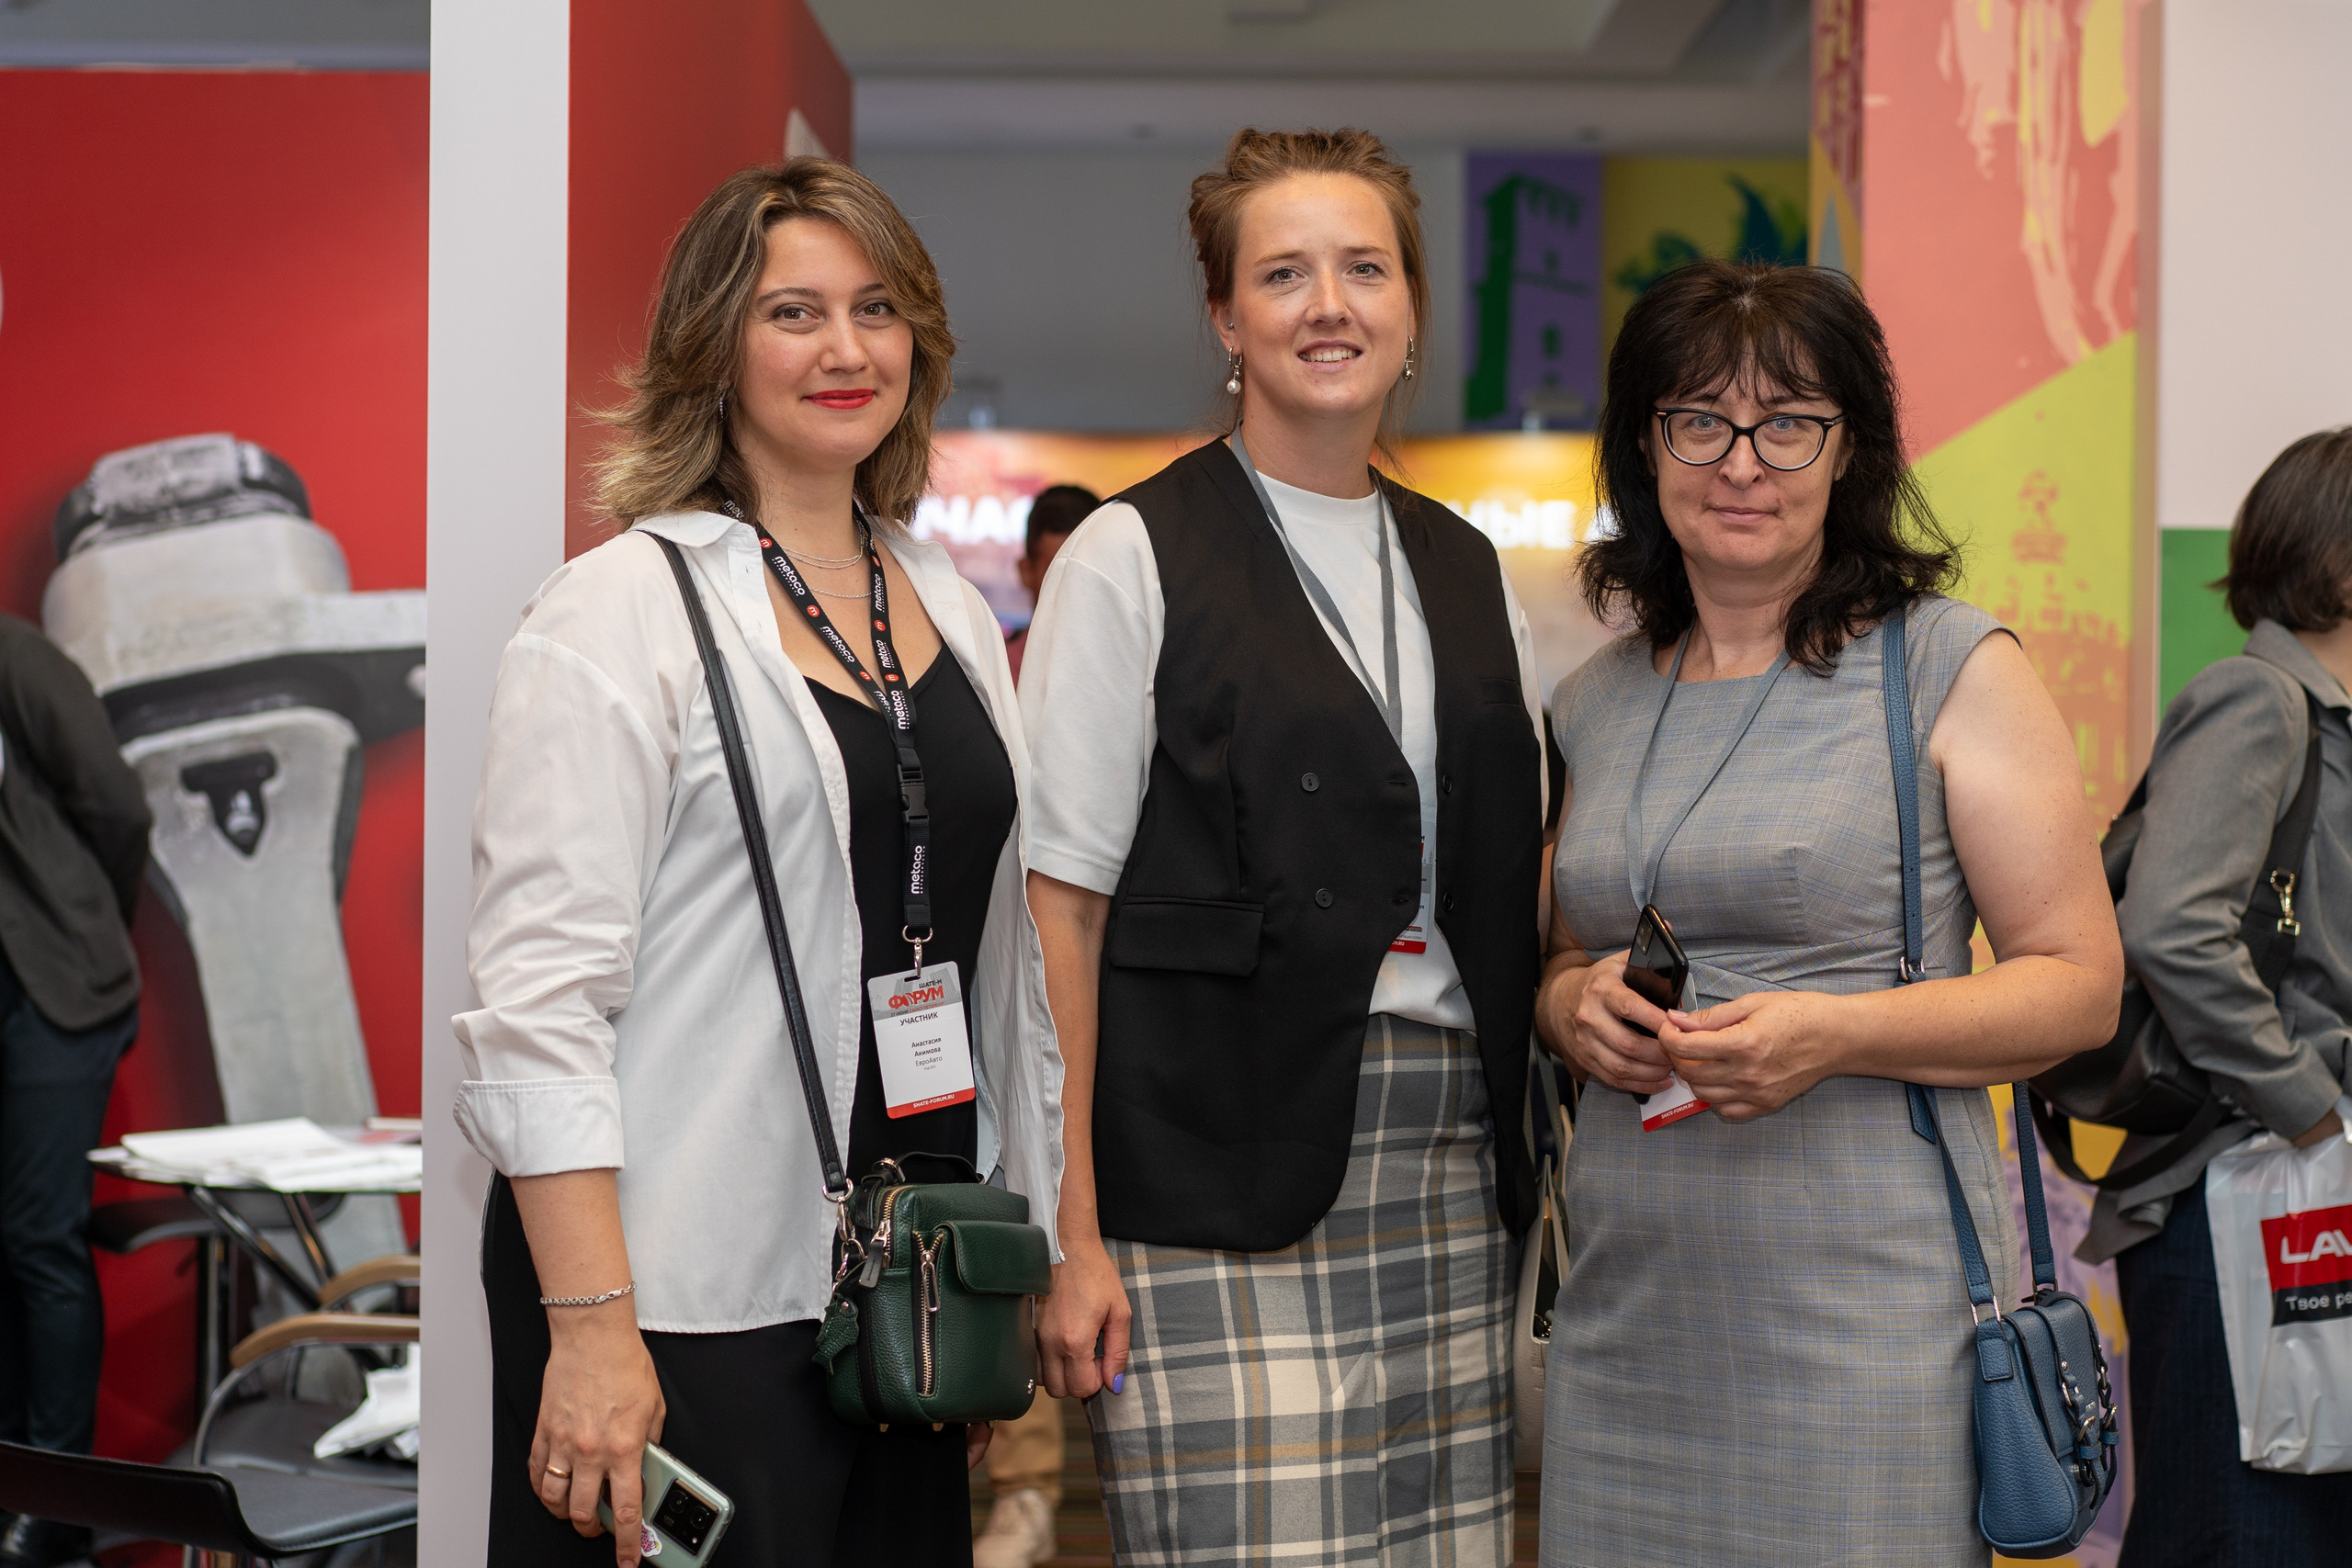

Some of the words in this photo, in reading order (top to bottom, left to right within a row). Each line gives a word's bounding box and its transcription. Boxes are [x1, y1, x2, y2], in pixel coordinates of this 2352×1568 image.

[775, 556, 806, 595] metaco
[875, 573, 883, 612] metaco
[822, 626, 855, 663] metaco
[876, 639, 892, 669] metaco
[890, 690, 907, 730] metaco
[910, 845, 922, 895] metaco
[919, 978, 943, 989] ШАТЕ-М
[899, 1011, 939, 1026] УЧАСТНИК
[911, 1037, 942, 1048] Анастасия
[914, 1046, 942, 1057] Акимова
[915, 1055, 943, 1066] ЕвроАвто
[912, 1094, 955, 1108] SHATE-FORUM.RU
[1661, 1102, 1694, 1119] SHATE-FORUM.RU
[2284, 1295, 2330, 1311] Твое
